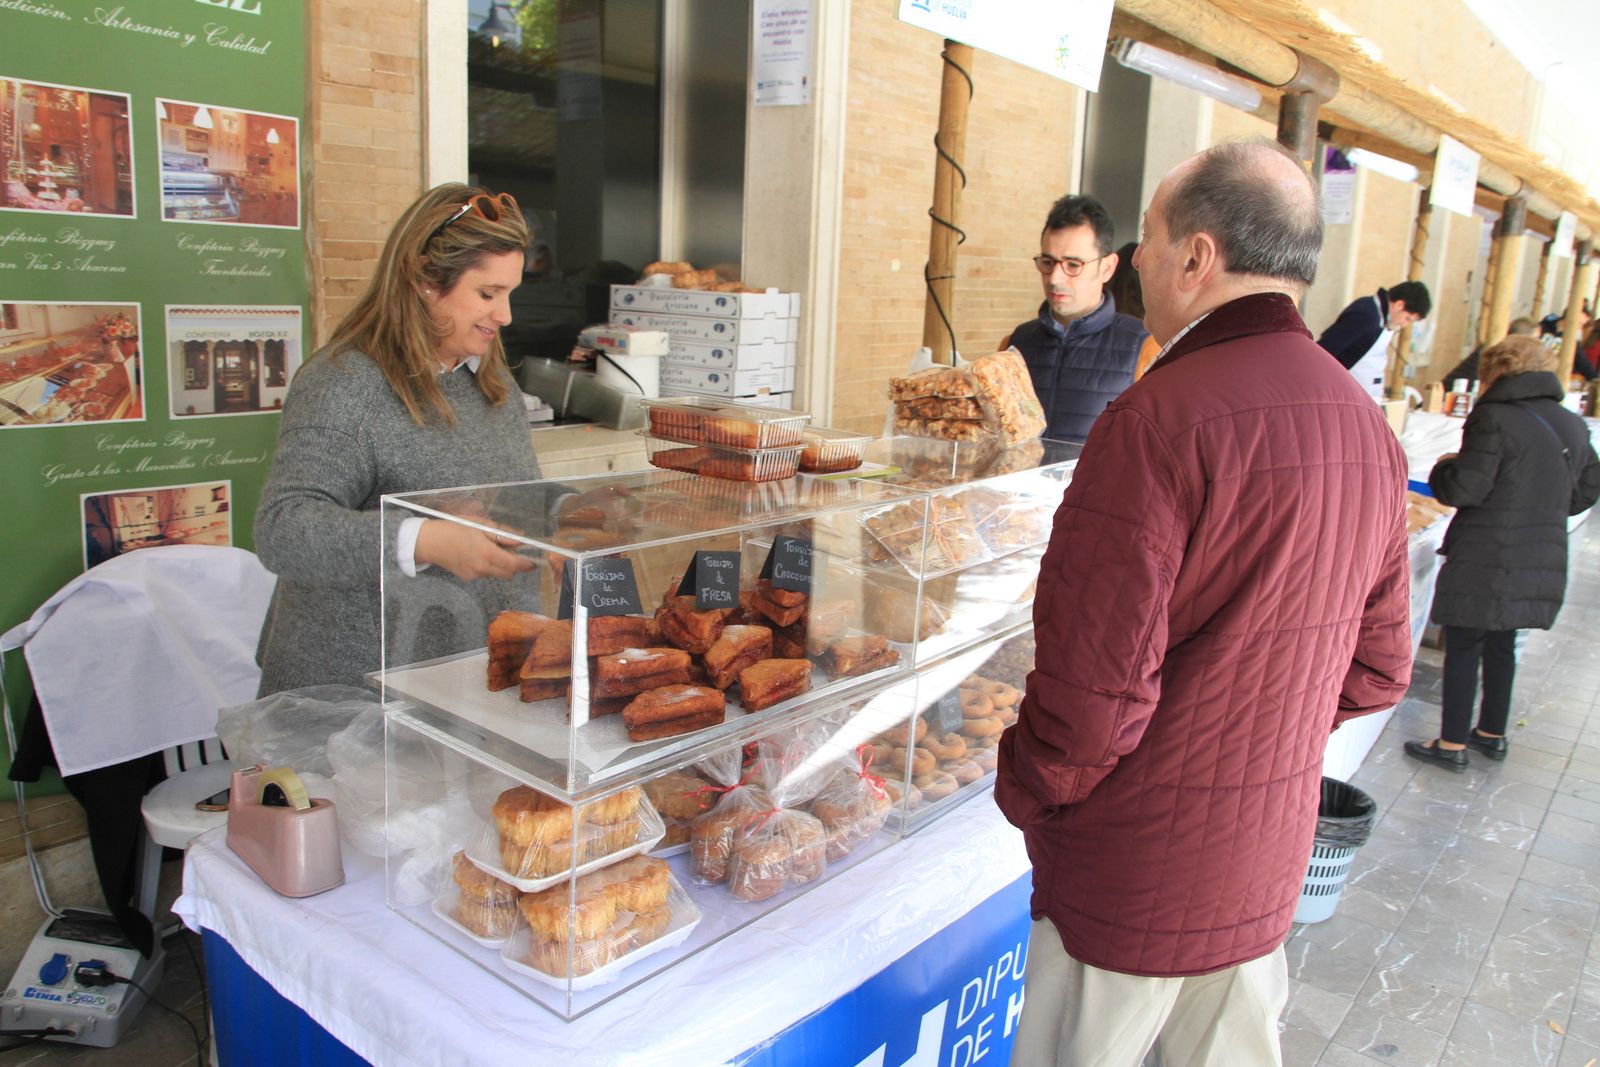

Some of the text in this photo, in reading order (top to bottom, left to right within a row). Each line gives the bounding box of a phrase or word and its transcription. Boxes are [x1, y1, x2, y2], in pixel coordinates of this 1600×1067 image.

[942, 3, 967, 19] HUELVA
[180, 34, 197, 48] y
[203, 22, 272, 55] Calidad
[52, 261, 63, 271] 5
[66, 255, 128, 273] Aracena
[40, 463, 86, 487] Gruta
[86, 463, 101, 477] de
[103, 460, 121, 475] las
[126, 455, 197, 473] Maravillas
[798, 555, 809, 567] de
[582, 563, 625, 582] TORRIJAS
[716, 570, 726, 585] de
[602, 582, 613, 592] de
[701, 587, 733, 603] FRESA
[592, 593, 630, 607] CREMA
[951, 1012, 995, 1067] DE
